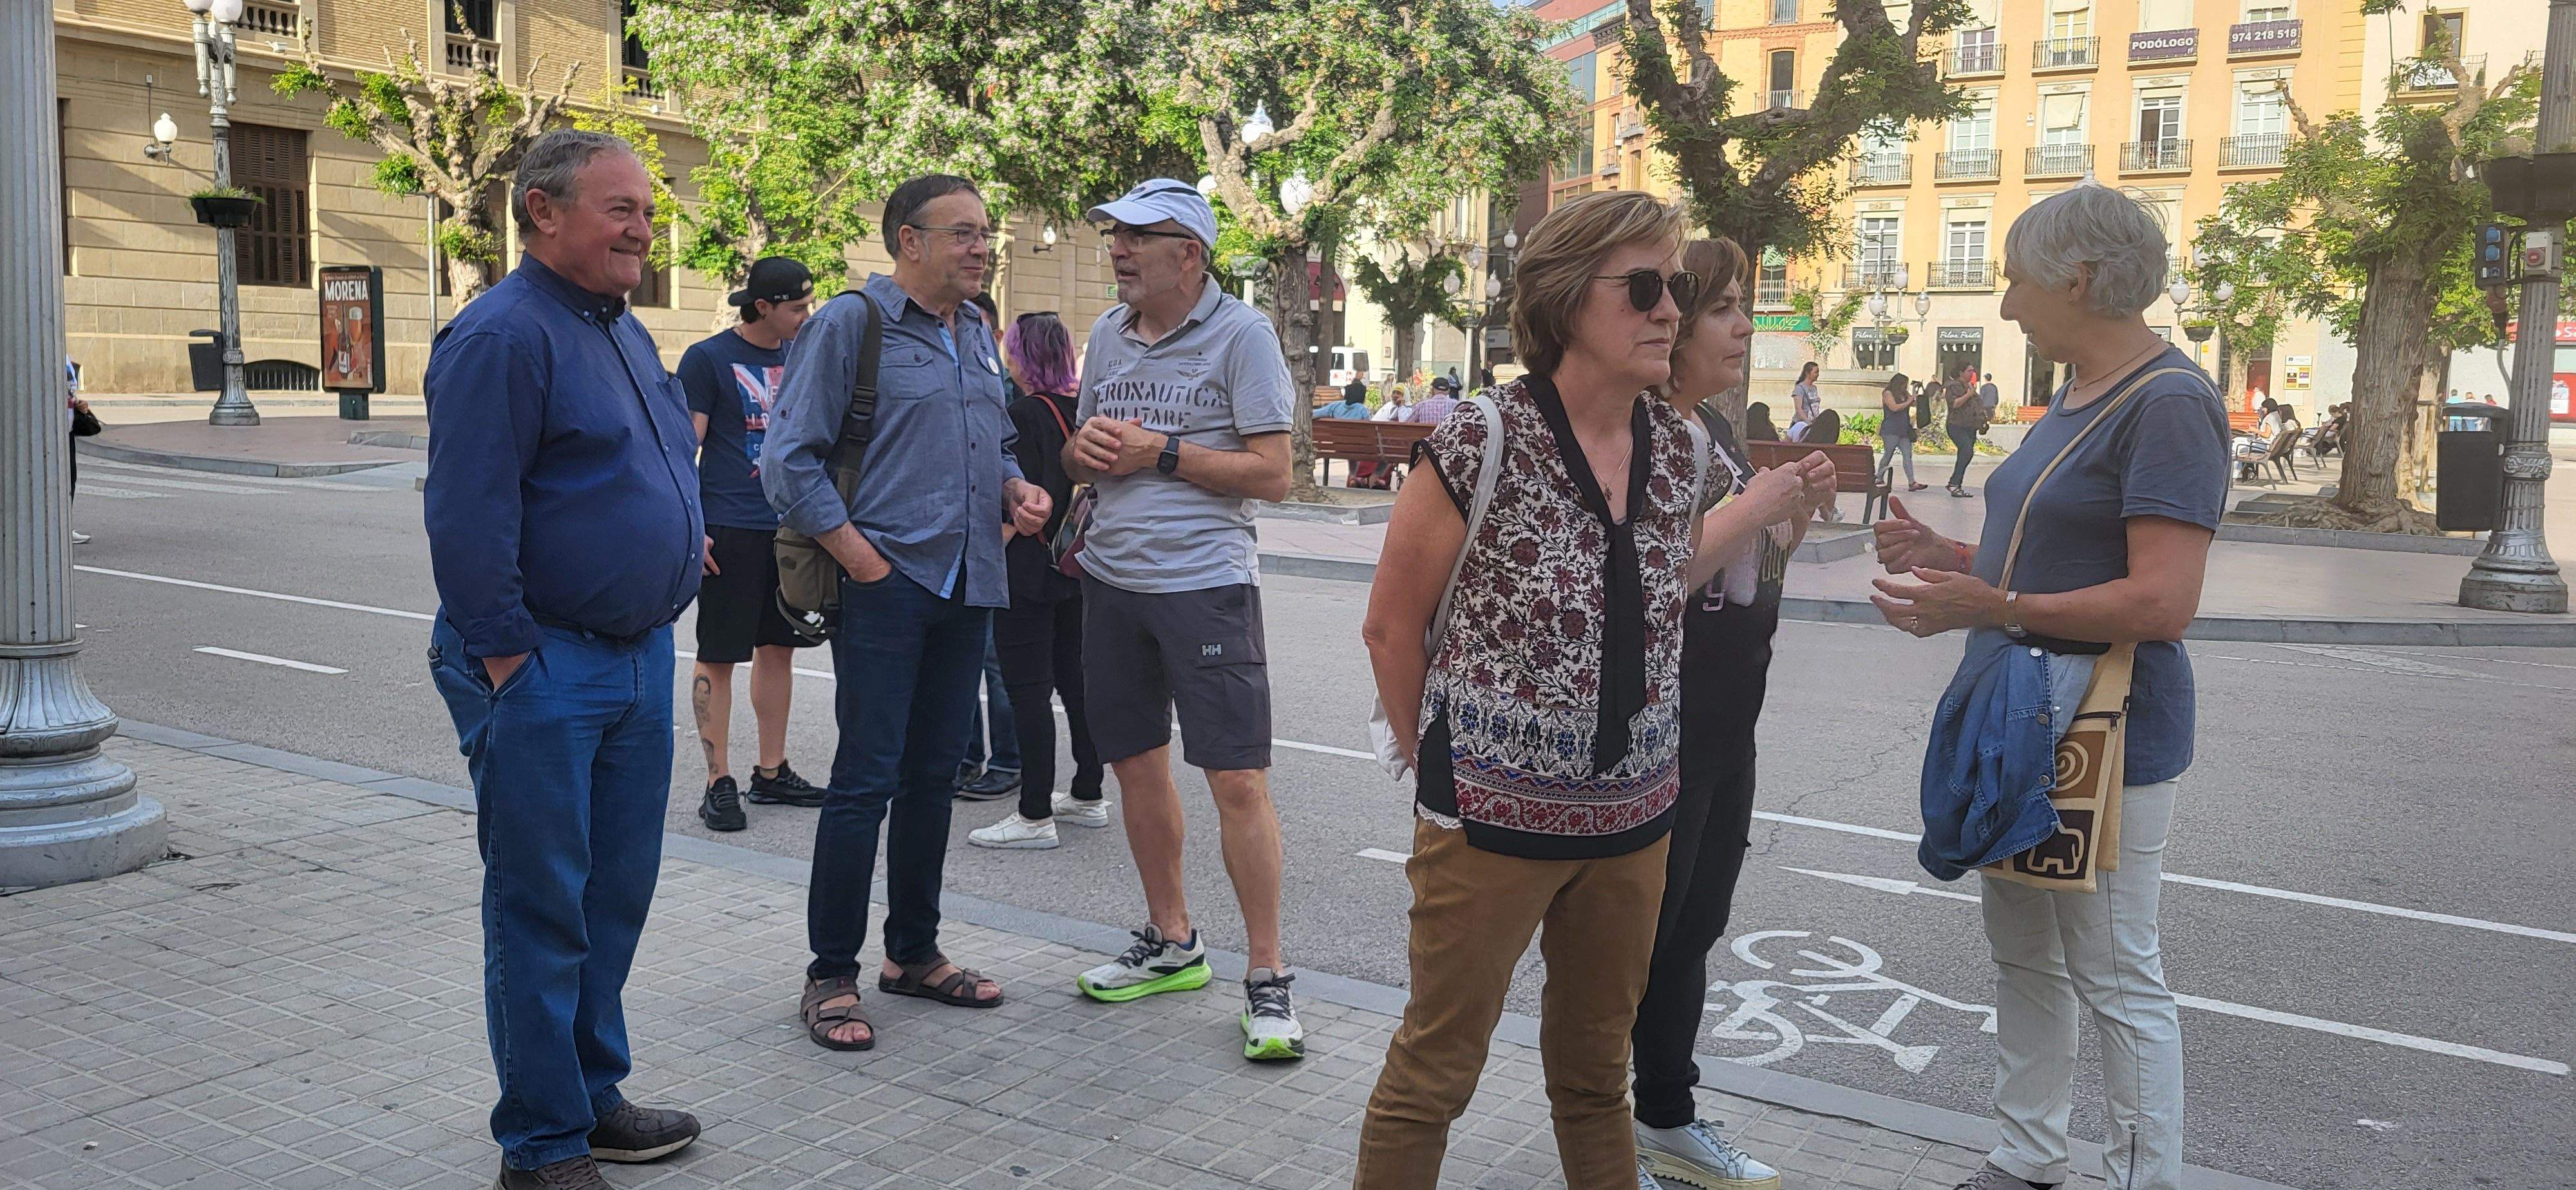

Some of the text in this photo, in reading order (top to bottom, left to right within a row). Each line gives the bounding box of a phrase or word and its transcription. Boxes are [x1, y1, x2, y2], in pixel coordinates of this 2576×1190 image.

[2231, 28, 2297, 42] 974 218 518
[2132, 37, 2194, 50] PODÓLOGO
[325, 280, 369, 301] MORENA
[1202, 644, 1222, 656] HH
